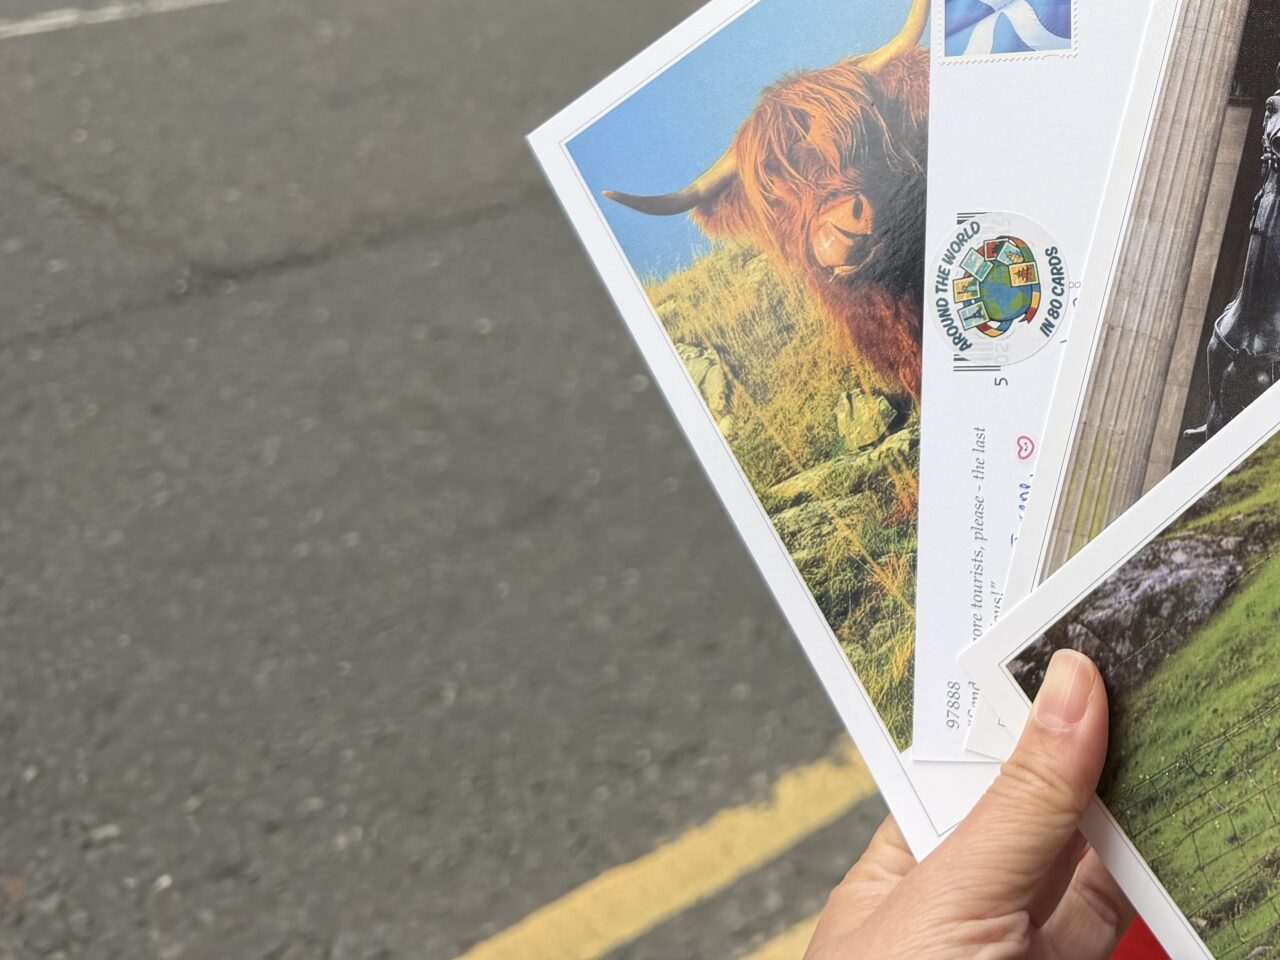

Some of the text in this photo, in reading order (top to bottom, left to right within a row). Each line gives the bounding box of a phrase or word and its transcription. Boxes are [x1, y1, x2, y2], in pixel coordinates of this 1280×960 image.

[935, 221, 981, 352] AROUND THE WORLD
[1039, 246, 1065, 337] IN 80 CARDS
[994, 376, 1008, 386] 5
[971, 426, 986, 452] last
[971, 454, 985, 479] the
[970, 496, 988, 541] please
[970, 547, 987, 608] tourists,
[946, 680, 961, 730] 97888
